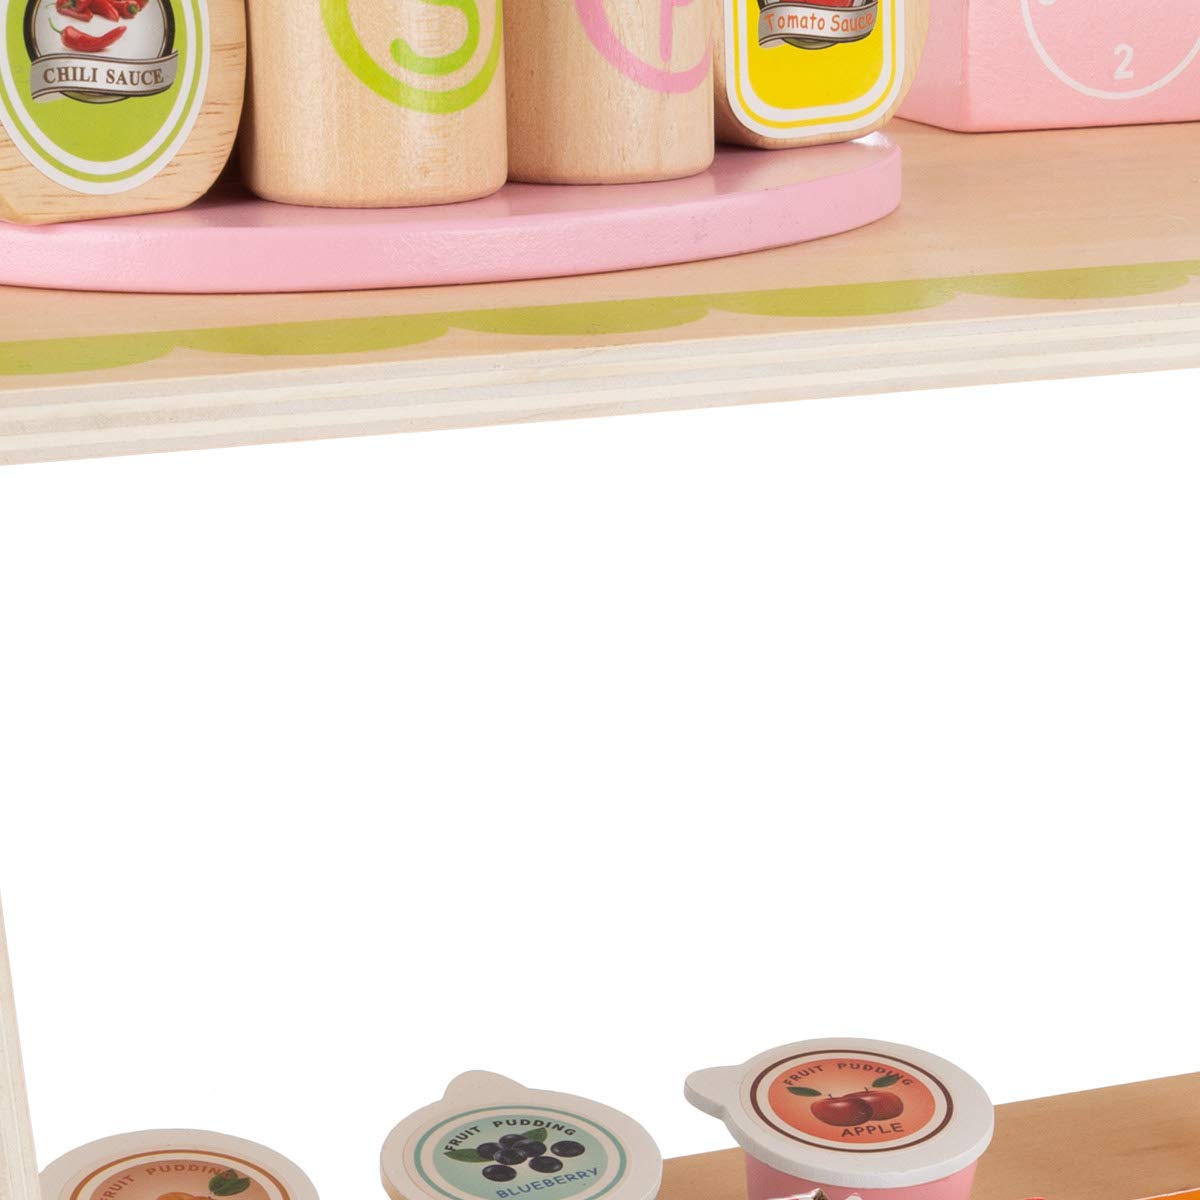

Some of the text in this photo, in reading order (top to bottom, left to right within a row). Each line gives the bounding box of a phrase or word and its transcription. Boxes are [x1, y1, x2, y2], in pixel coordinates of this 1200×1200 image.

[764, 12, 874, 32] Tomato Sauce
[1113, 43, 1134, 80] 2
[43, 66, 164, 86] CHILI SAUCE
[783, 1063, 913, 1086] FRUIT PUDDING
[445, 1119, 576, 1152] FRUIT PUDDING
[841, 1122, 904, 1138] APPLE
[146, 1164, 233, 1181] PUDDIN
[496, 1167, 598, 1199] BLUEBERRY
